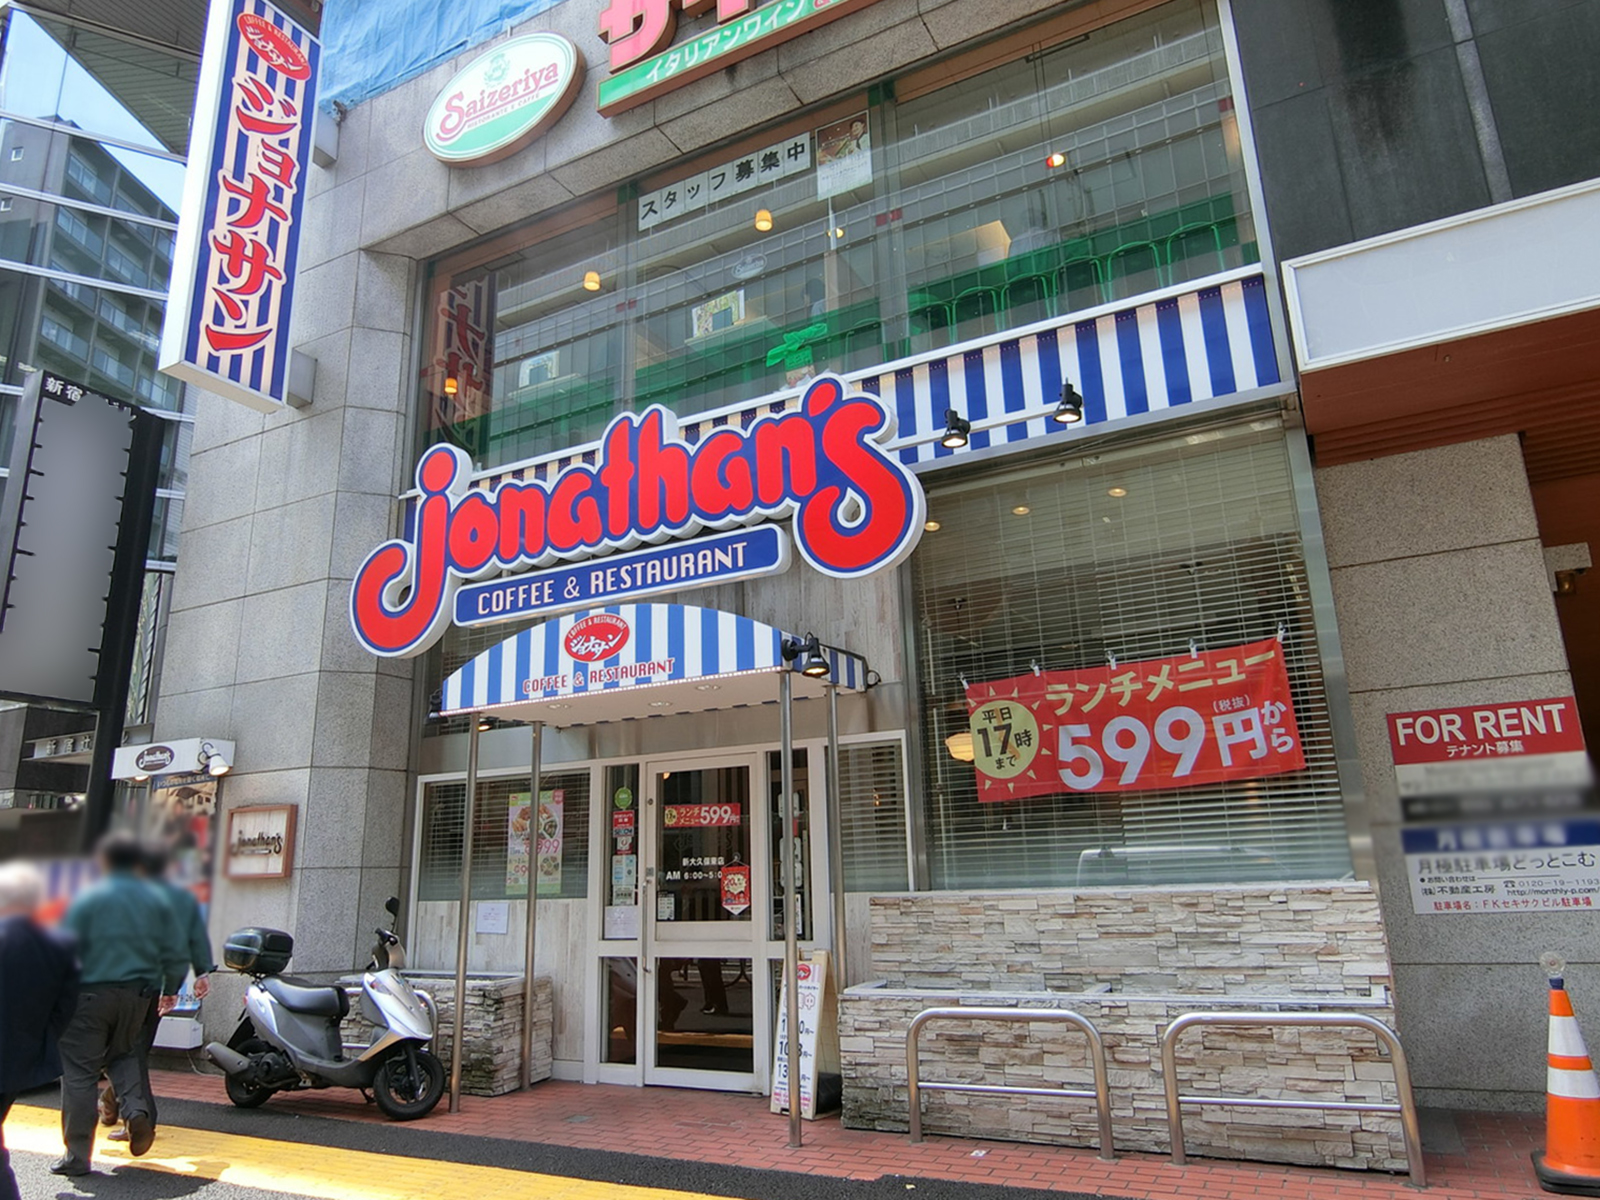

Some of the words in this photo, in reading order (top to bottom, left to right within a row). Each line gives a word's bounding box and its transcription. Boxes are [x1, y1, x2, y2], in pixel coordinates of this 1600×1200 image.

[598, 0, 749, 71] サ
[646, 1, 803, 82] イタリアンワイン
[435, 62, 559, 141] Saizeriya
[641, 142, 805, 220] スタッフ募集中
[205, 77, 298, 351] ジョナサン
[477, 580, 554, 616] COFFEE
[563, 577, 580, 598] &
[589, 541, 748, 595] RESTAURANT
[568, 621, 587, 640] COFFEE
[593, 615, 628, 630] RESTAURANT
[522, 674, 568, 695] COFFEE
[574, 671, 585, 687] &
[589, 658, 675, 685] RESTAURANT
[1045, 650, 1276, 717] ランチメニュー
[977, 722, 1033, 758] 17時
[982, 707, 1012, 724] 平日
[1396, 713, 1467, 746] FOR
[1473, 703, 1566, 740] RENT
[995, 755, 1017, 770] まで
[1057, 705, 1269, 791] 599円
[1260, 700, 1294, 754] から
[1446, 740, 1526, 758] テナント募集
[666, 870, 681, 881] AM
[684, 871, 724, 881] 6:00~5:0
